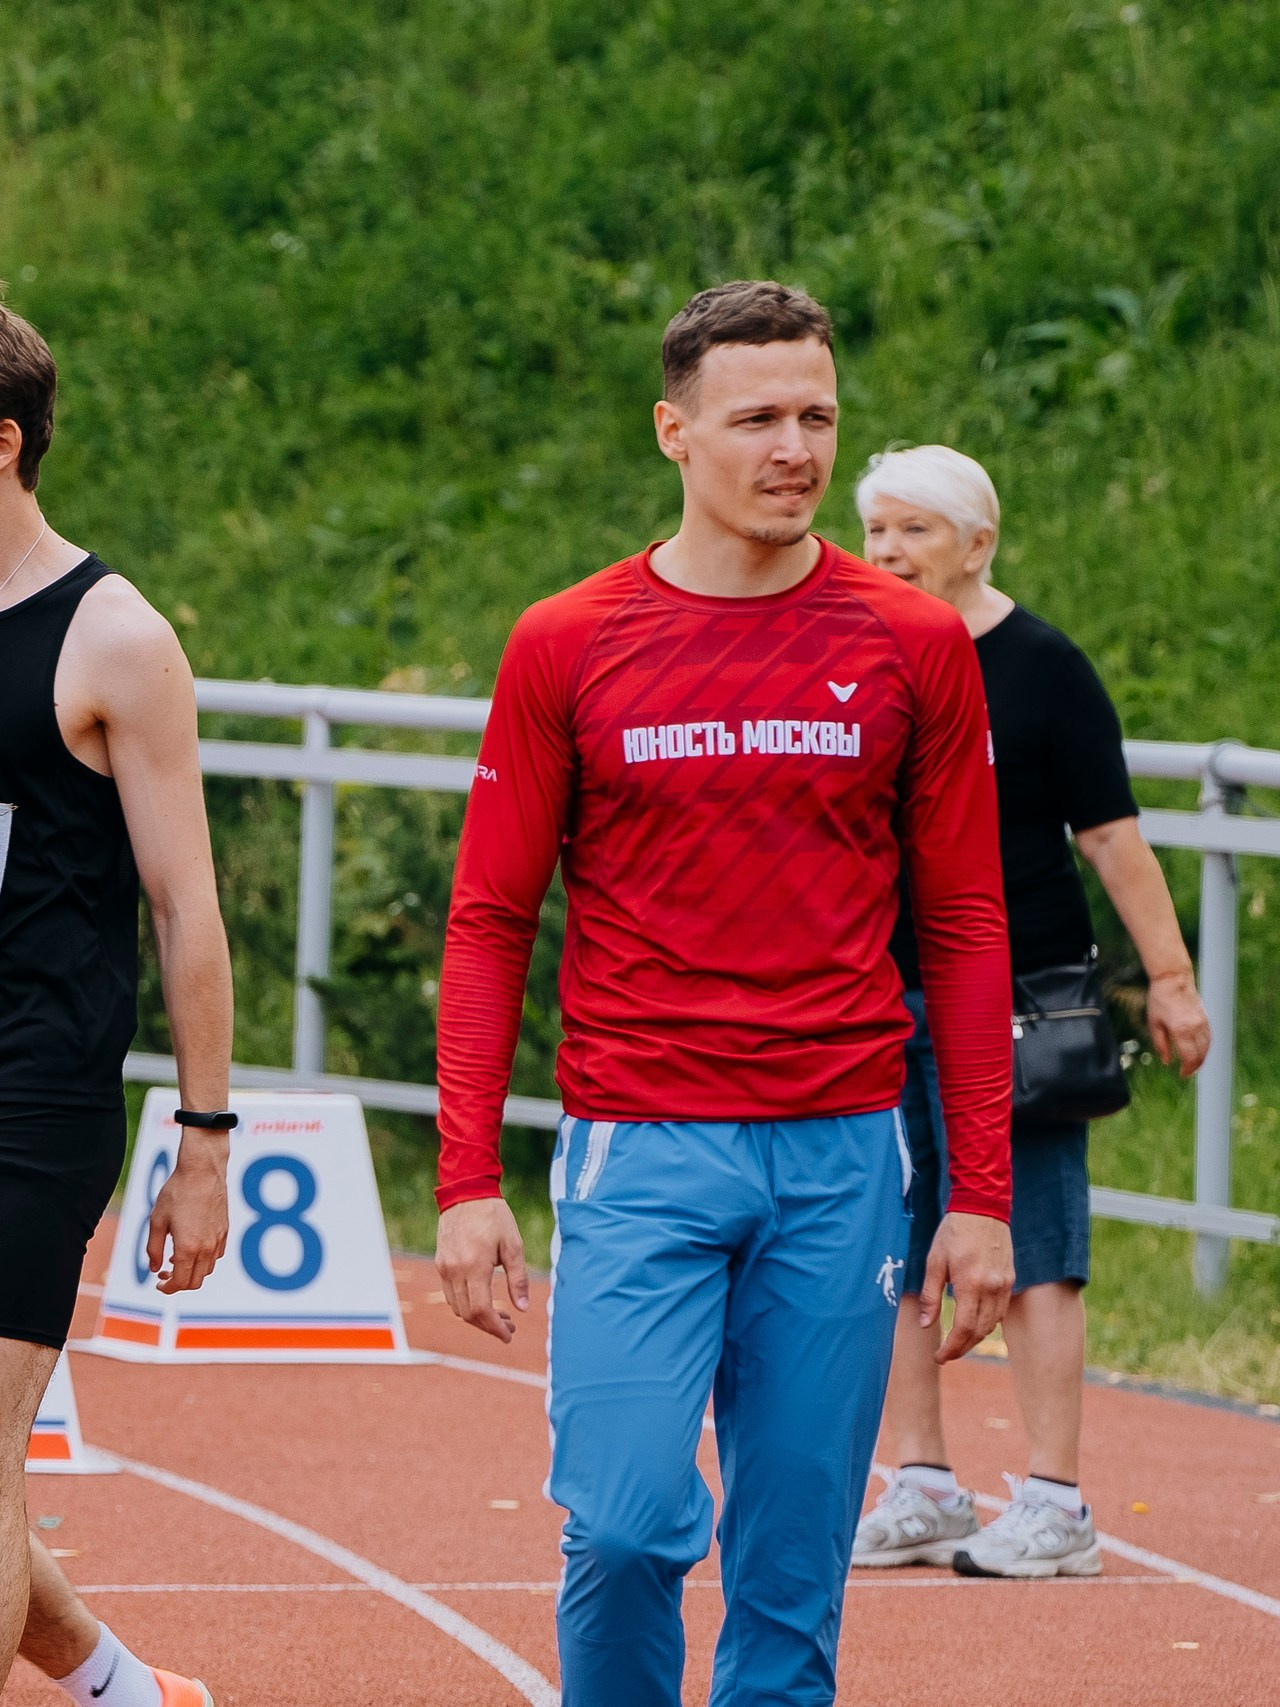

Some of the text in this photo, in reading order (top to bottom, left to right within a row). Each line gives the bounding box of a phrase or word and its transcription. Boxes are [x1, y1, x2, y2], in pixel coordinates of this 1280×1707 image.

[623, 720, 860, 763] ЮНОСТЬ МОСКВЫ
[240, 1155, 322, 1291] 8
